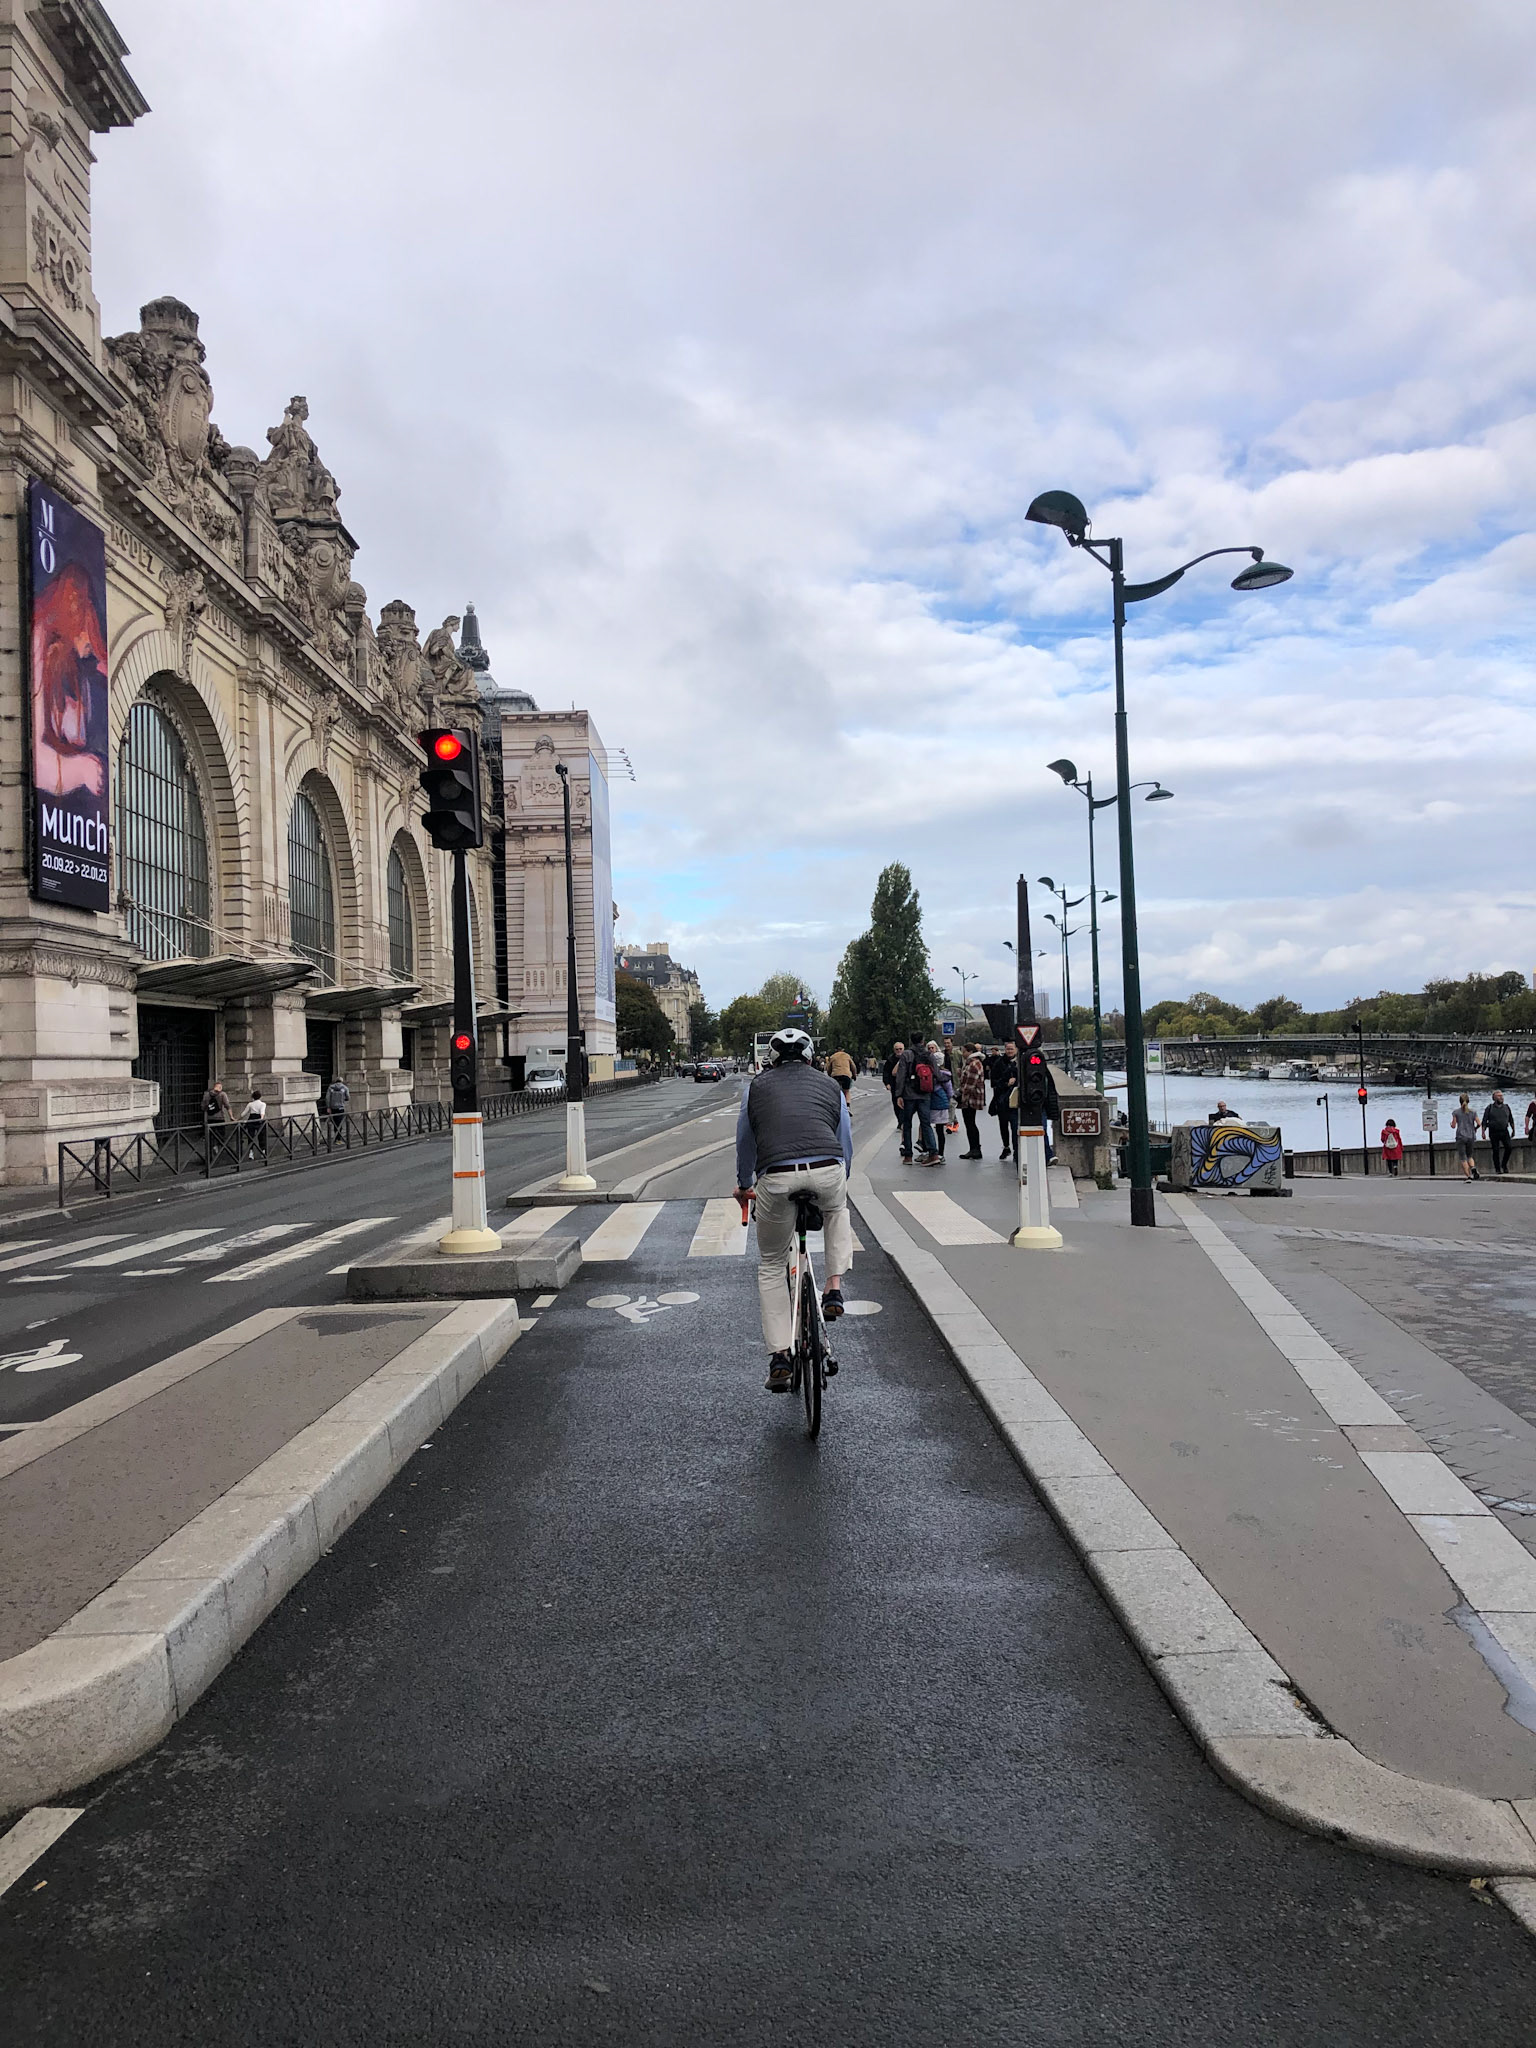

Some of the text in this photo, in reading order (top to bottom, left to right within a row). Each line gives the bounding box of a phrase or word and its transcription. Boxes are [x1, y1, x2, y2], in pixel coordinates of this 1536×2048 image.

[110, 521, 155, 574] RODEZ
[42, 803, 107, 854] Munch
[42, 853, 74, 875] 20.09.22
[81, 864, 107, 883] 22.01.23
